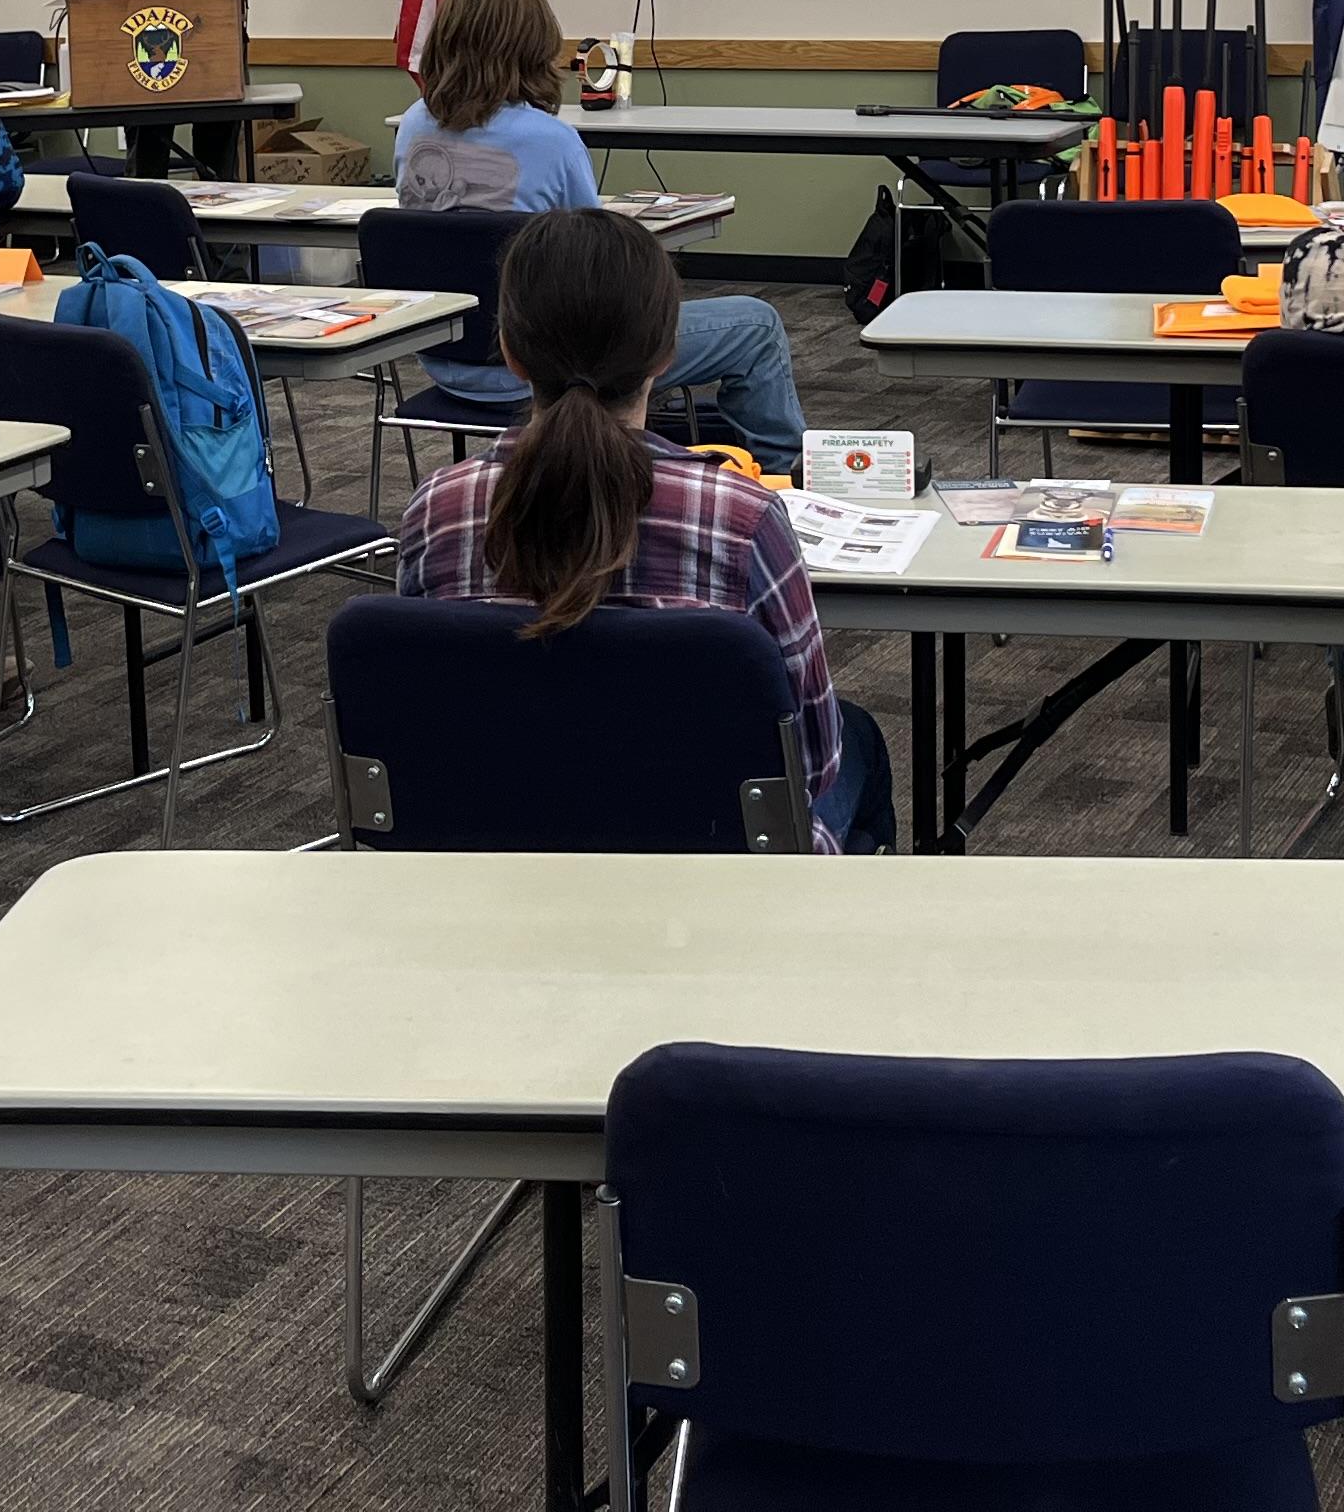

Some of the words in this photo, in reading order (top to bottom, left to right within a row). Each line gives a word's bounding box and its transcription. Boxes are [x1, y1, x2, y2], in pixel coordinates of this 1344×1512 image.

[123, 9, 189, 33] IDAHO
[129, 61, 150, 86] FISH
[161, 59, 188, 88] GAME
[822, 439, 860, 447] FIREARM
[862, 439, 894, 447] SAFETY
